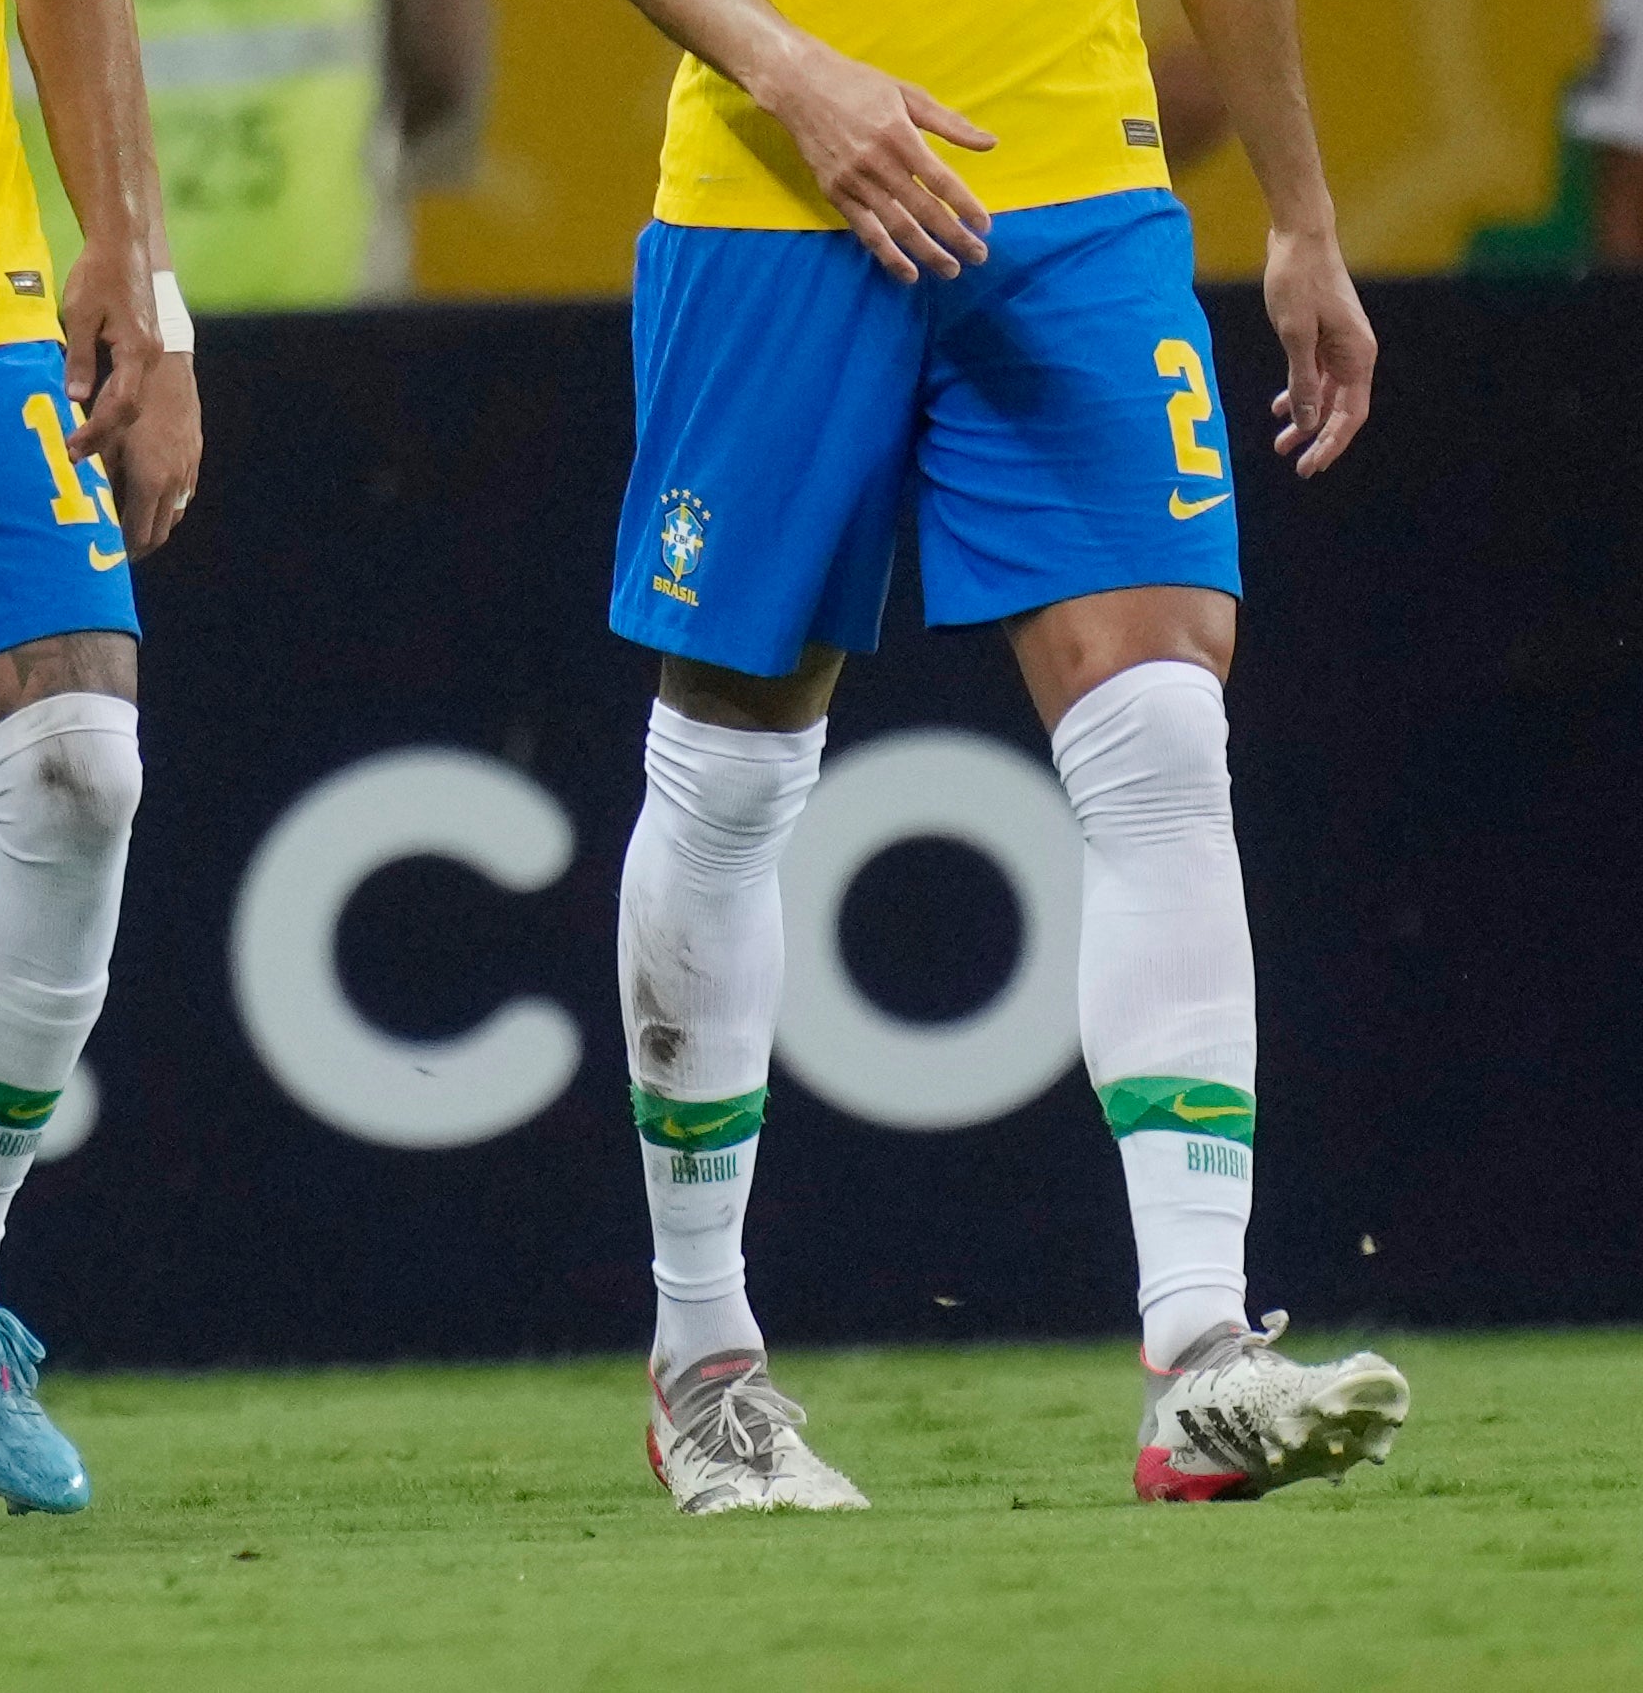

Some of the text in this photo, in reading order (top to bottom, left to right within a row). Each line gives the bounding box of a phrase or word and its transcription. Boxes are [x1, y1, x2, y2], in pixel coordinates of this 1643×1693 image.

[1152, 338, 1223, 480] 2
[673, 533, 691, 546] CBF
[652, 574, 700, 607] BRASIL
